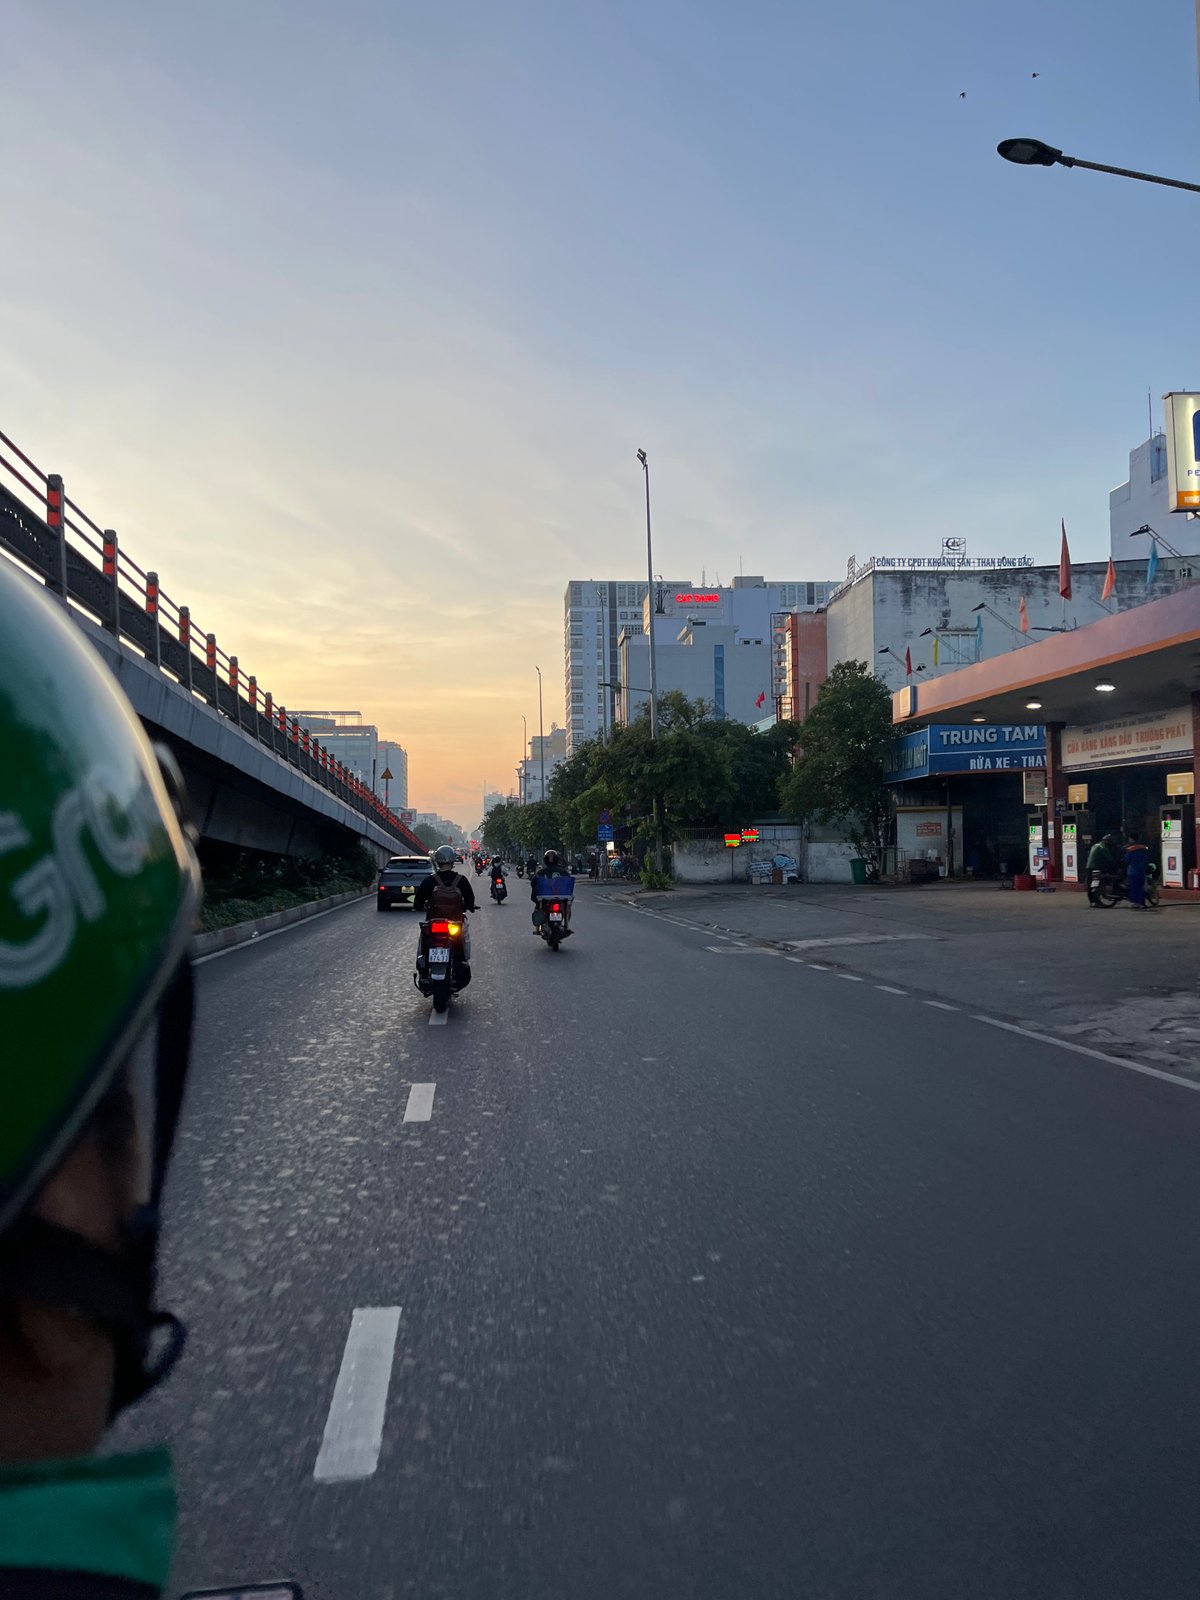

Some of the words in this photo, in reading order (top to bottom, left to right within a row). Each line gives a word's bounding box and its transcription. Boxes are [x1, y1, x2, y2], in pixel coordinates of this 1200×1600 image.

[876, 556, 895, 567] CÔNG
[896, 558, 906, 567] TY
[977, 558, 996, 567] THAN
[940, 728, 998, 745] TRUNG
[995, 757, 1010, 769] XE
